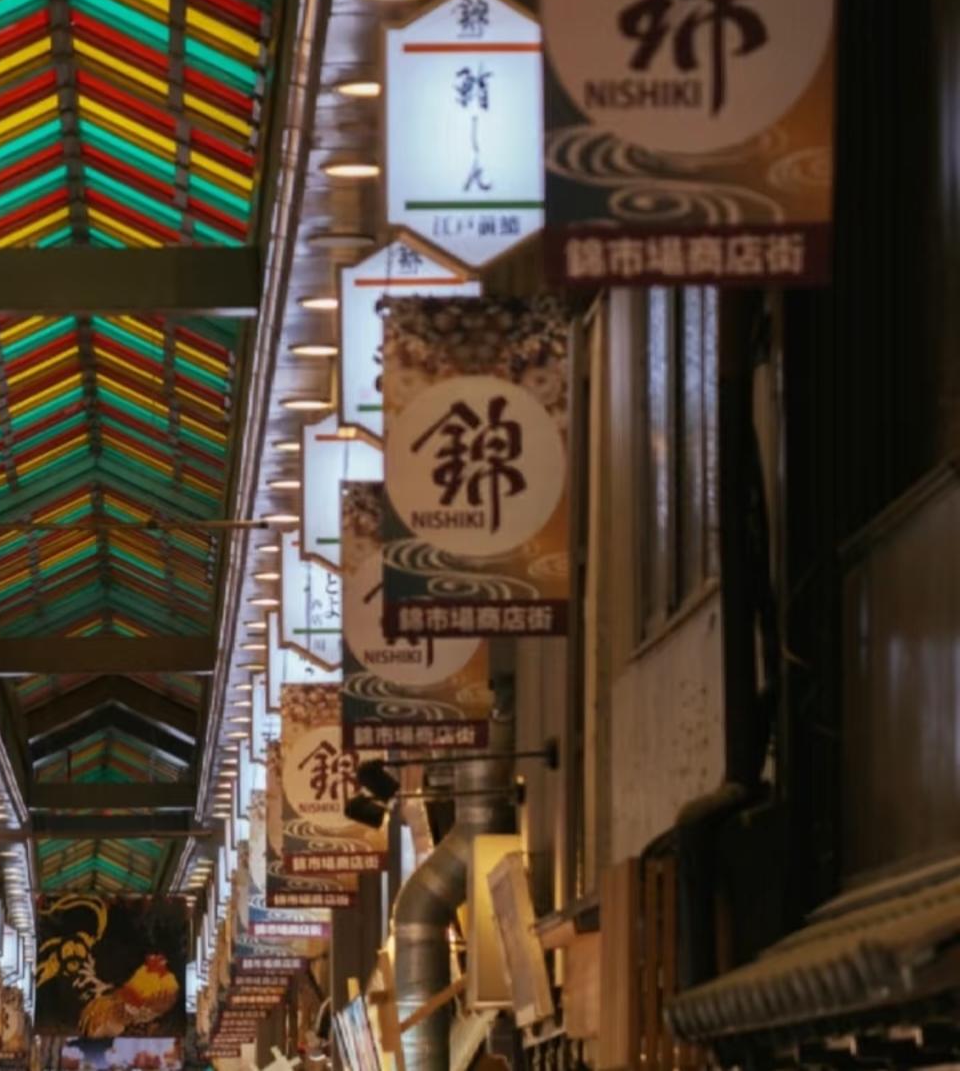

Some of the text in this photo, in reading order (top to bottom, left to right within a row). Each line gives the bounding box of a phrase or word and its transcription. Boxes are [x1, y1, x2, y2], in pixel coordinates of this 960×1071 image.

[585, 79, 702, 109] NISHIKI
[566, 237, 806, 277] 錦市場商店街
[410, 395, 527, 536] 錦
[411, 509, 485, 529] NISHIKI
[399, 606, 552, 631] 錦市場商店街
[364, 649, 422, 665] NISHIKI
[354, 726, 475, 746] 錦市場商店街
